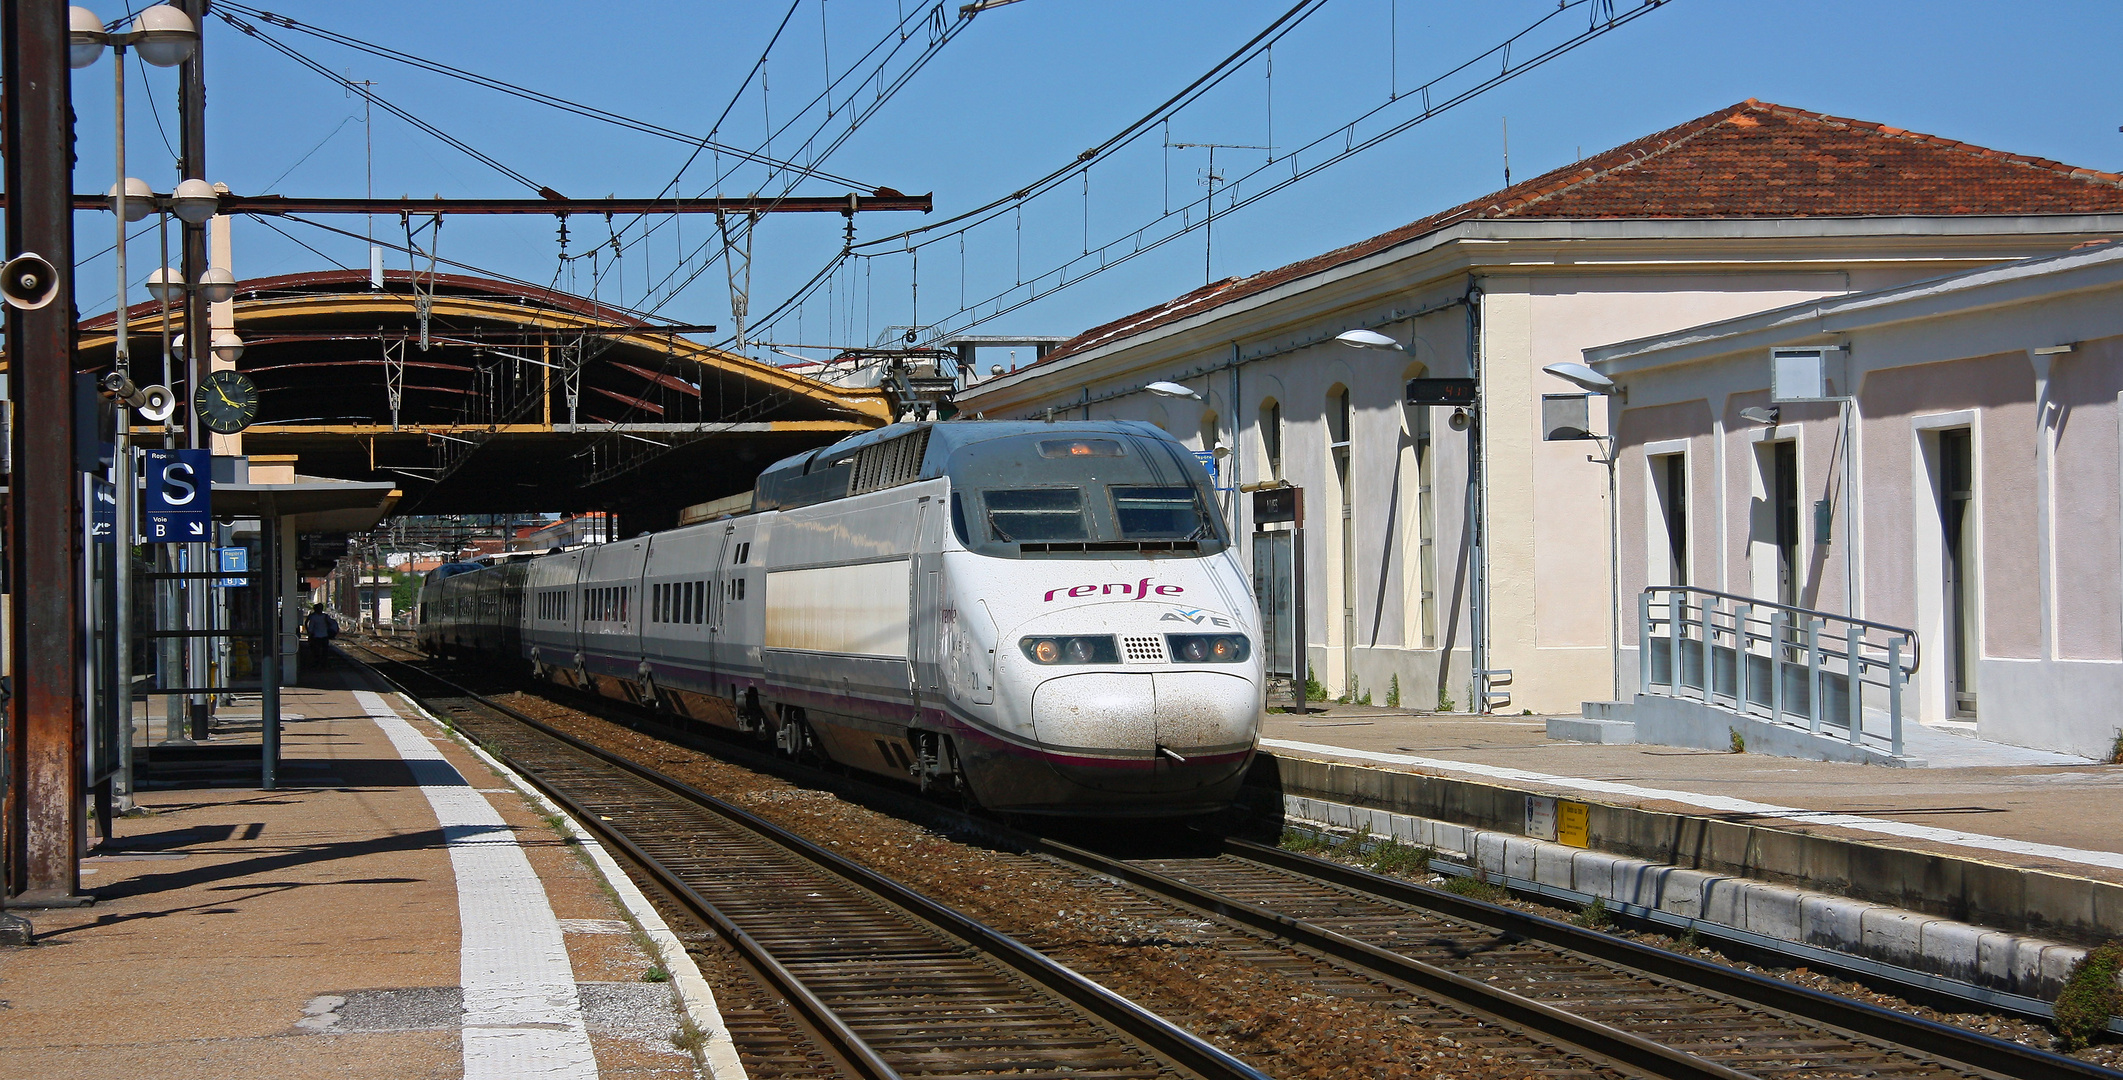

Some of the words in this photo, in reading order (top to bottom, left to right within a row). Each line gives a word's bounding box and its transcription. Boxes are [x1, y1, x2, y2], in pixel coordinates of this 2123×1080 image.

[162, 462, 196, 506] S
[156, 524, 166, 537] B
[229, 556, 240, 568] T
[1043, 576, 1185, 603] renfe
[1159, 610, 1232, 628] AVE
